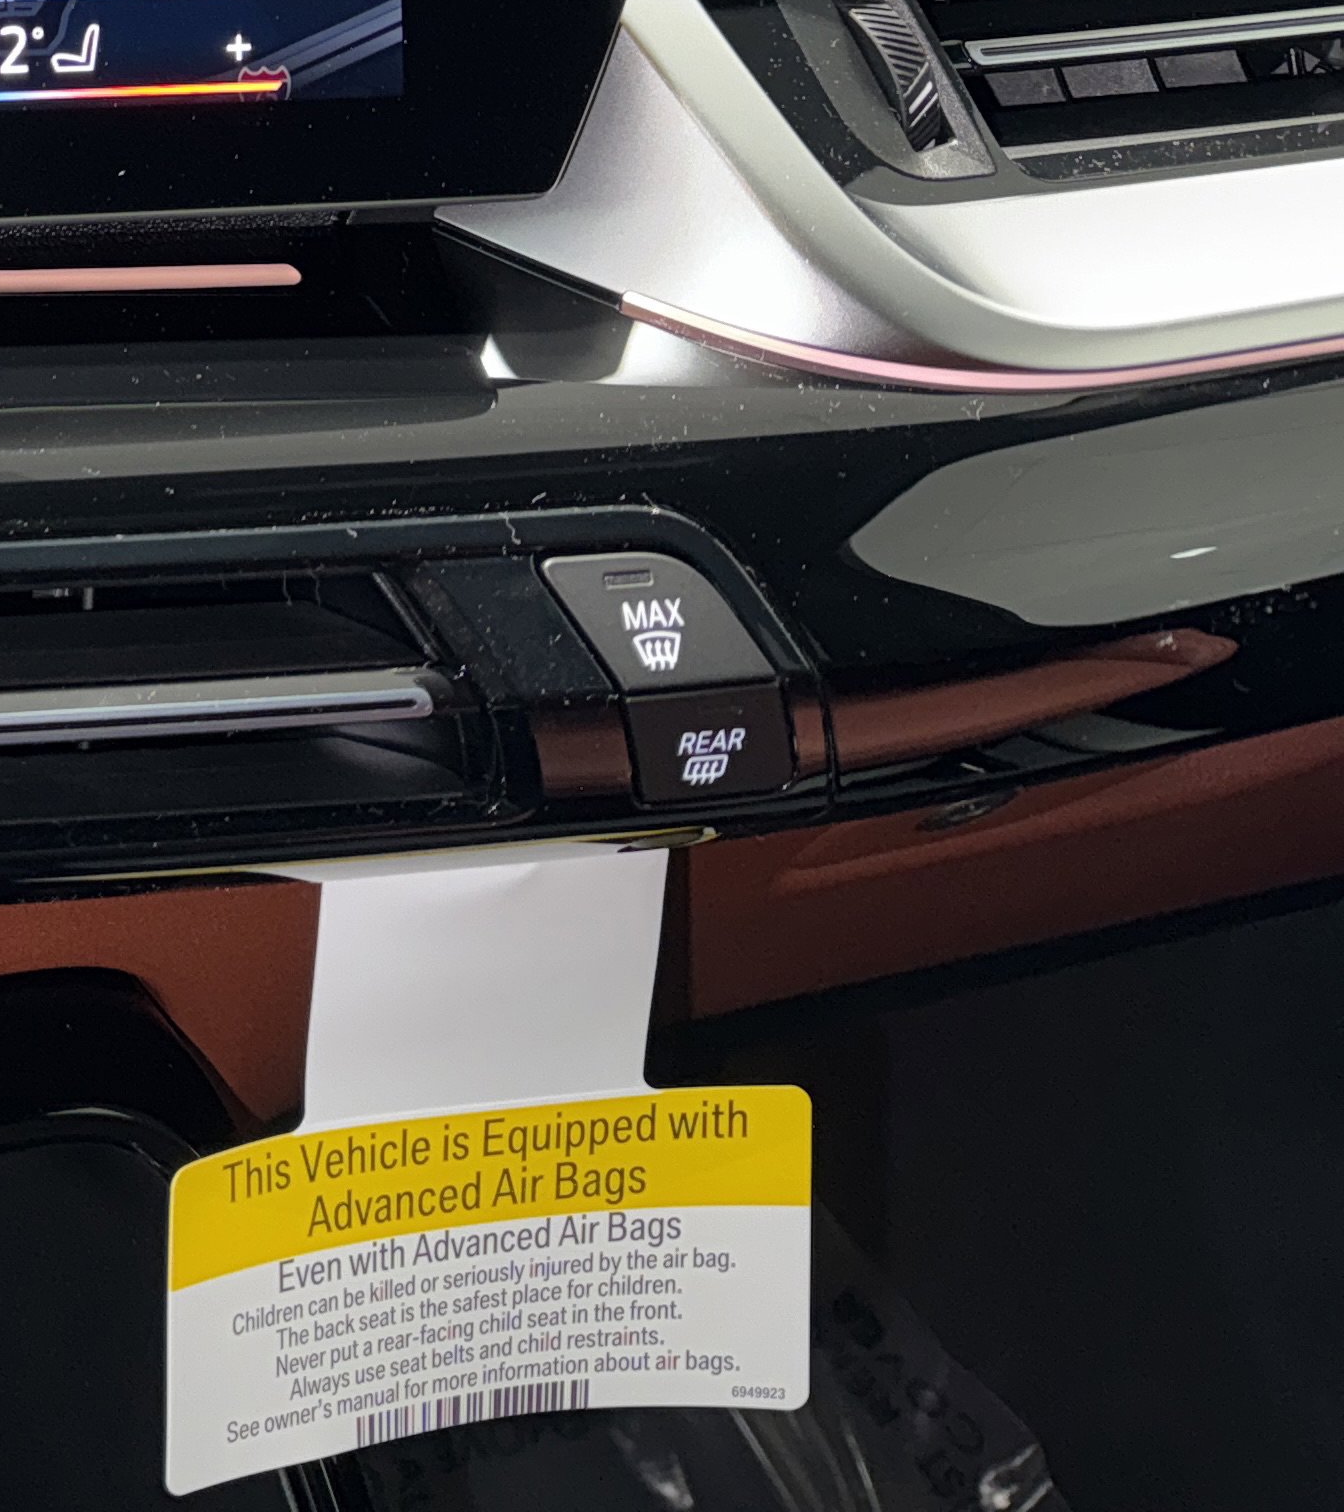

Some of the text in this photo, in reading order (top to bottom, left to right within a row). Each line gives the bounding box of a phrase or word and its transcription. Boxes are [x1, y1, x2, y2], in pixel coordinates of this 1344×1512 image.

[621, 596, 686, 631] MAX
[677, 727, 747, 757] REAR
[222, 1099, 748, 1203] This Vehicle is Equipped with
[307, 1160, 647, 1238] Advanced Air Bags
[232, 1246, 737, 1336] Children can be killed or seriously injured by the air bag.
[278, 1211, 682, 1293] Even with Advanced Air Bags
[275, 1299, 683, 1378] Never put a rear-facing child seat in the front.
[276, 1273, 683, 1351] The back seat is the safest place for children.
[226, 1348, 741, 1444] See owner's manual for more information about air bags.
[289, 1325, 665, 1401] Always use seat belts and child restraints.
[730, 1385, 787, 1401] 6949923
